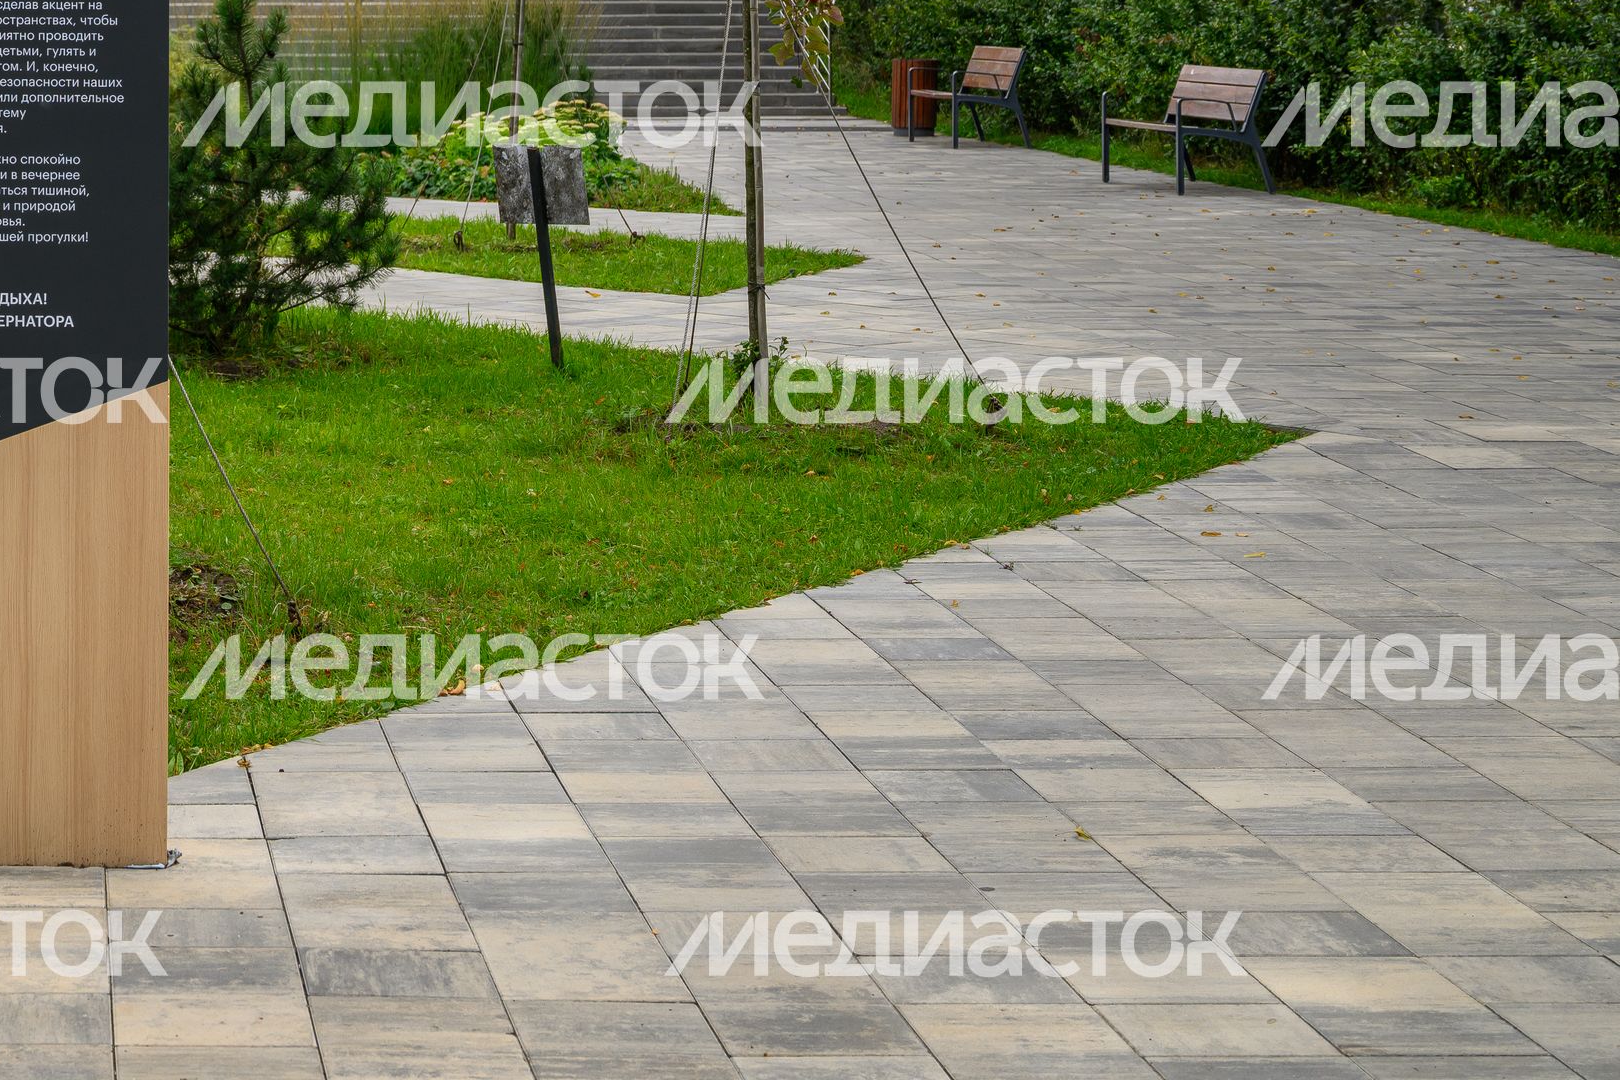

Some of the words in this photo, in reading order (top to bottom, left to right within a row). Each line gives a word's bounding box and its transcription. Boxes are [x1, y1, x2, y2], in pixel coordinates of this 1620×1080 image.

[41, 1, 85, 12] акцент
[88, 1, 103, 11] на
[79, 13, 118, 26] чтобы
[38, 32, 105, 44] проводить
[46, 47, 86, 59] гулять
[88, 47, 97, 57] и
[26, 60, 40, 73] И,
[43, 62, 99, 74] конечно,
[82, 78, 123, 88] наших
[20, 93, 125, 105] дополнительное
[20, 153, 81, 165] спокойно
[0, 171, 8, 180] и
[10, 171, 18, 180] в
[21, 171, 81, 183] вечернее
[30, 184, 90, 198] тишиной,
[2, 202, 11, 211] и
[13, 199, 76, 214] природой
[27, 231, 89, 245] прогулки!
